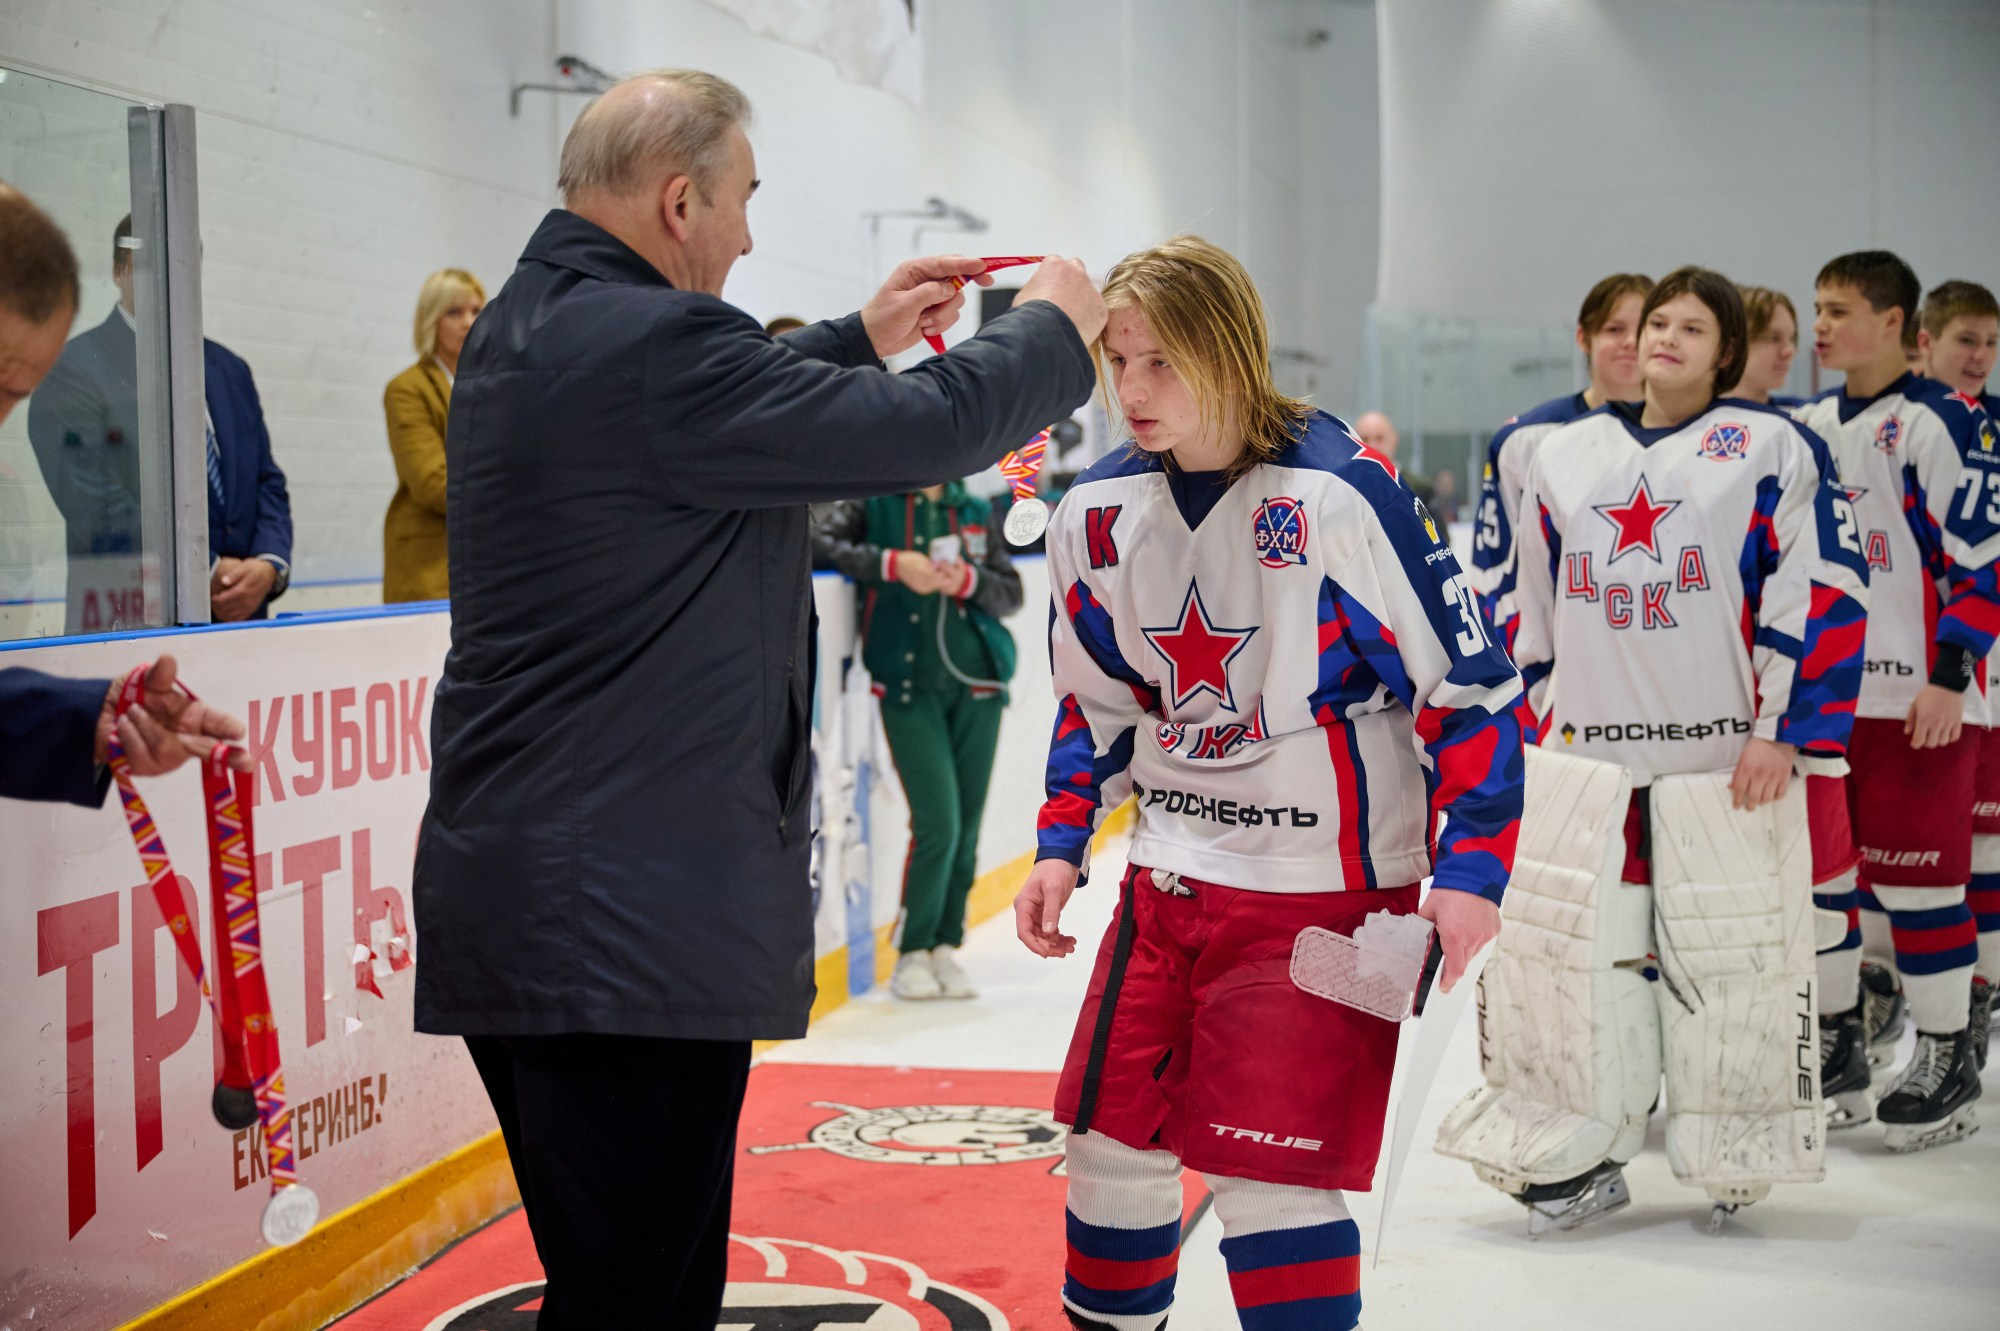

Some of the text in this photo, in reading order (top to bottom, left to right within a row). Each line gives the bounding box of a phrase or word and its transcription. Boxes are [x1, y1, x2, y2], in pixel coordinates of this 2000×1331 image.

[1255, 529, 1298, 550] ФХМ
[1566, 545, 1710, 630] ЦСКА
[1863, 660, 1914, 676] ФТЬ
[248, 676, 430, 807] КУБОК
[1585, 717, 1751, 742] РОСНЕФТЬ
[1145, 788, 1319, 828] РОСНЕФТЬ
[1797, 980, 1812, 1102] TRUE
[1209, 1123, 1323, 1151] TRUE
